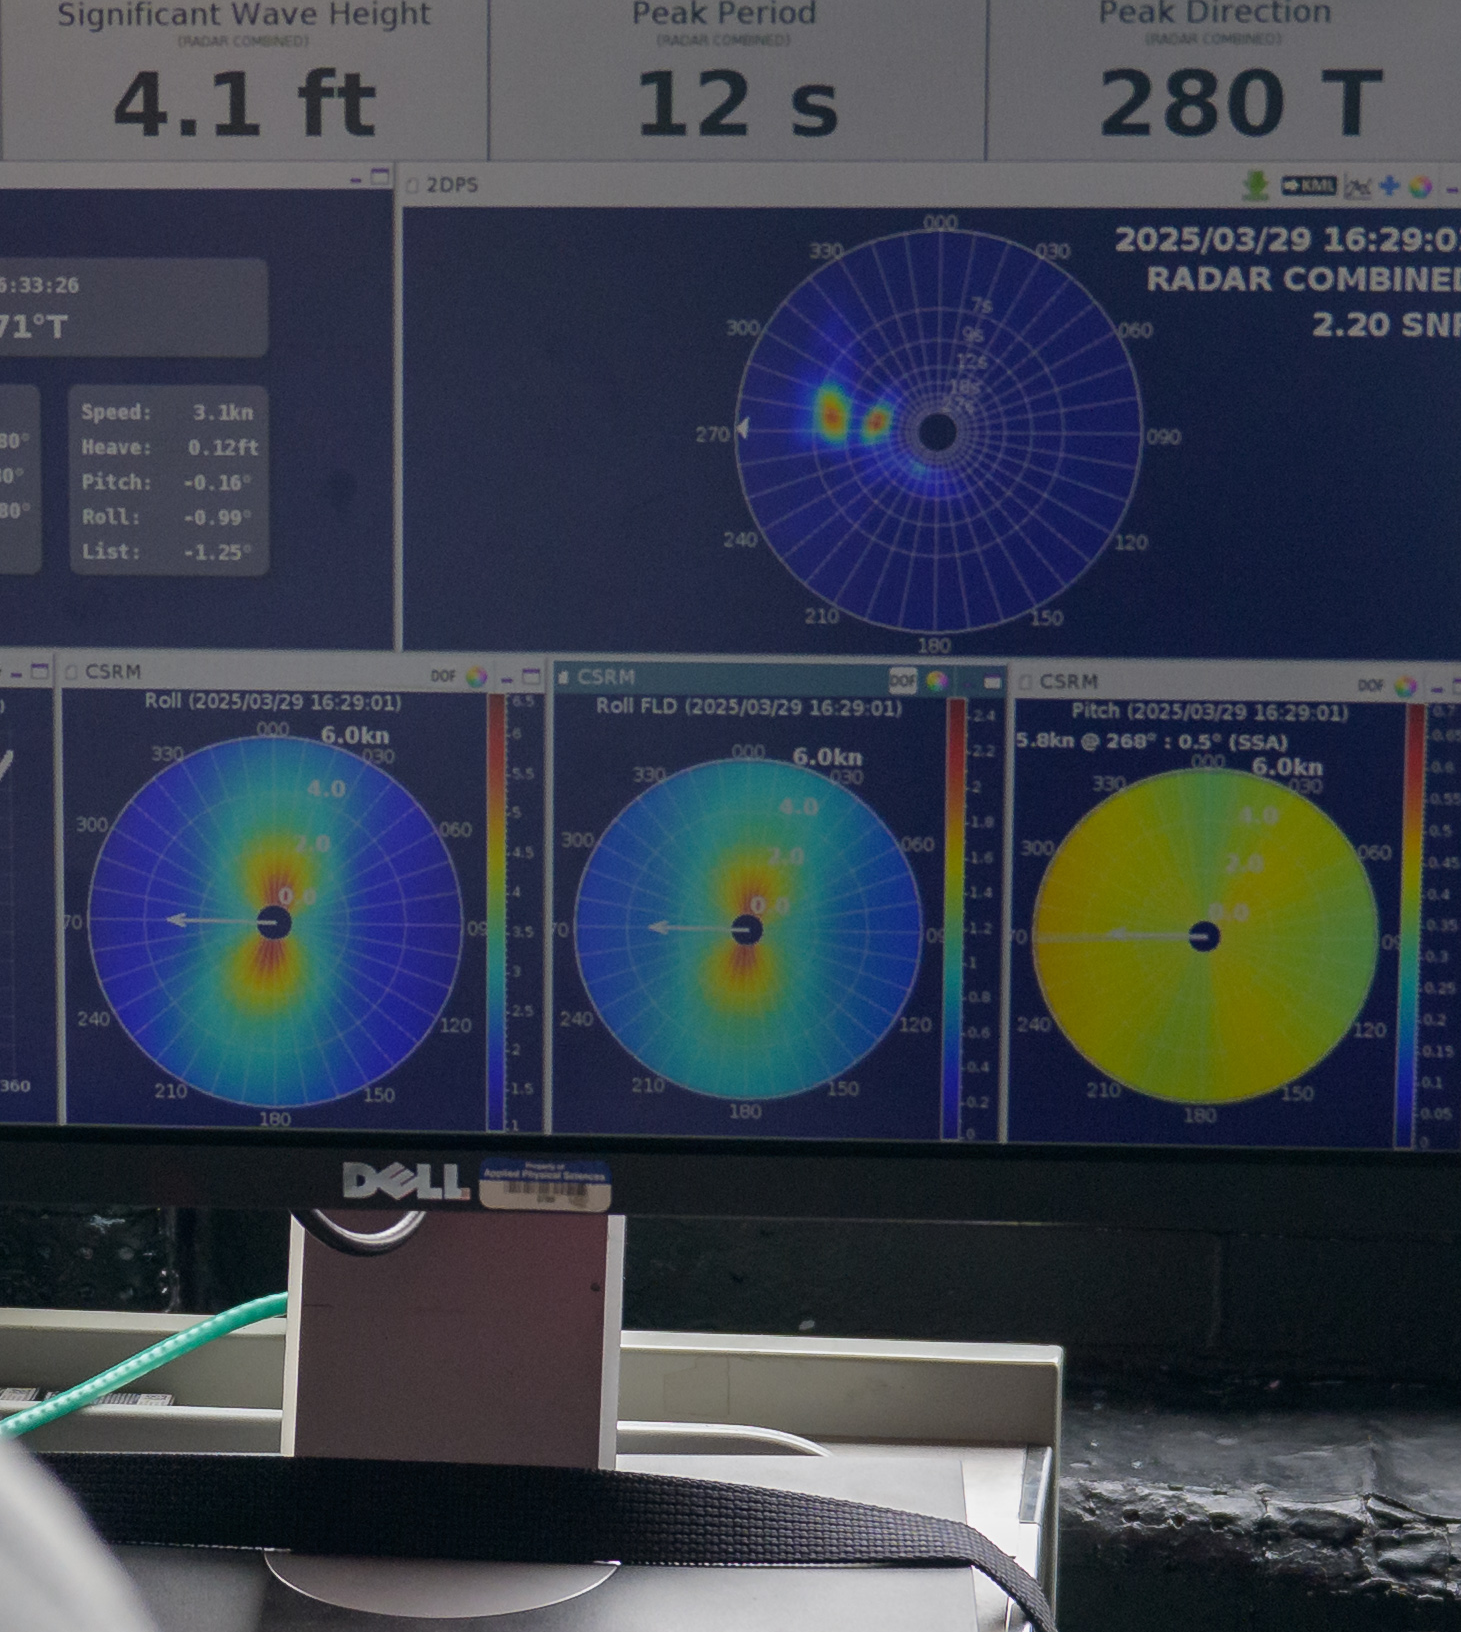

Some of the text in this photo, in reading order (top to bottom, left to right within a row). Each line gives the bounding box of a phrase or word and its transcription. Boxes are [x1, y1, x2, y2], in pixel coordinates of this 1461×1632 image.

[58, 1, 432, 33] Significant Wave Height
[633, 0, 817, 25] Peak Period
[1100, 0, 1332, 24] Peak Direction
[114, 67, 376, 137] 4.1 ft
[639, 69, 839, 138] 12 s
[1100, 68, 1384, 138] 280 T
[426, 177, 478, 193] 2DPS
[1300, 179, 1335, 194] KML
[808, 243, 845, 259] 330
[1114, 227, 1312, 256] 2025/03/29
[1147, 266, 1272, 293] RADAR
[1117, 322, 1153, 340] 060
[1312, 312, 1391, 339] 2.20
[81, 403, 253, 423] Speed: 3.1kn
[695, 427, 731, 444] 270
[81, 439, 259, 457] Heave: 0.12ft
[82, 474, 252, 491] Pitch: -0.16°
[82, 509, 252, 527] Roll: -0.99°
[82, 543, 252, 561] List: -1.25°
[85, 664, 141, 680] CSRM
[578, 669, 635, 686] CSRM
[1040, 674, 1098, 690] CSRM
[145, 692, 401, 713] Roll (2025/03/29 16:29:01)
[597, 698, 903, 719] Roll FLD (2025/03/29 16:29:01)
[1072, 703, 1349, 723] Pitch (2025/03/29 16:29:01)
[321, 726, 389, 745] 6.0kn
[1016, 732, 1289, 752] 5.8kn @ 268° 0.5° (SSA)
[793, 748, 863, 767] 6.0kn
[1252, 758, 1323, 777] 6.0kn
[343, 1161, 471, 1200] DELL
